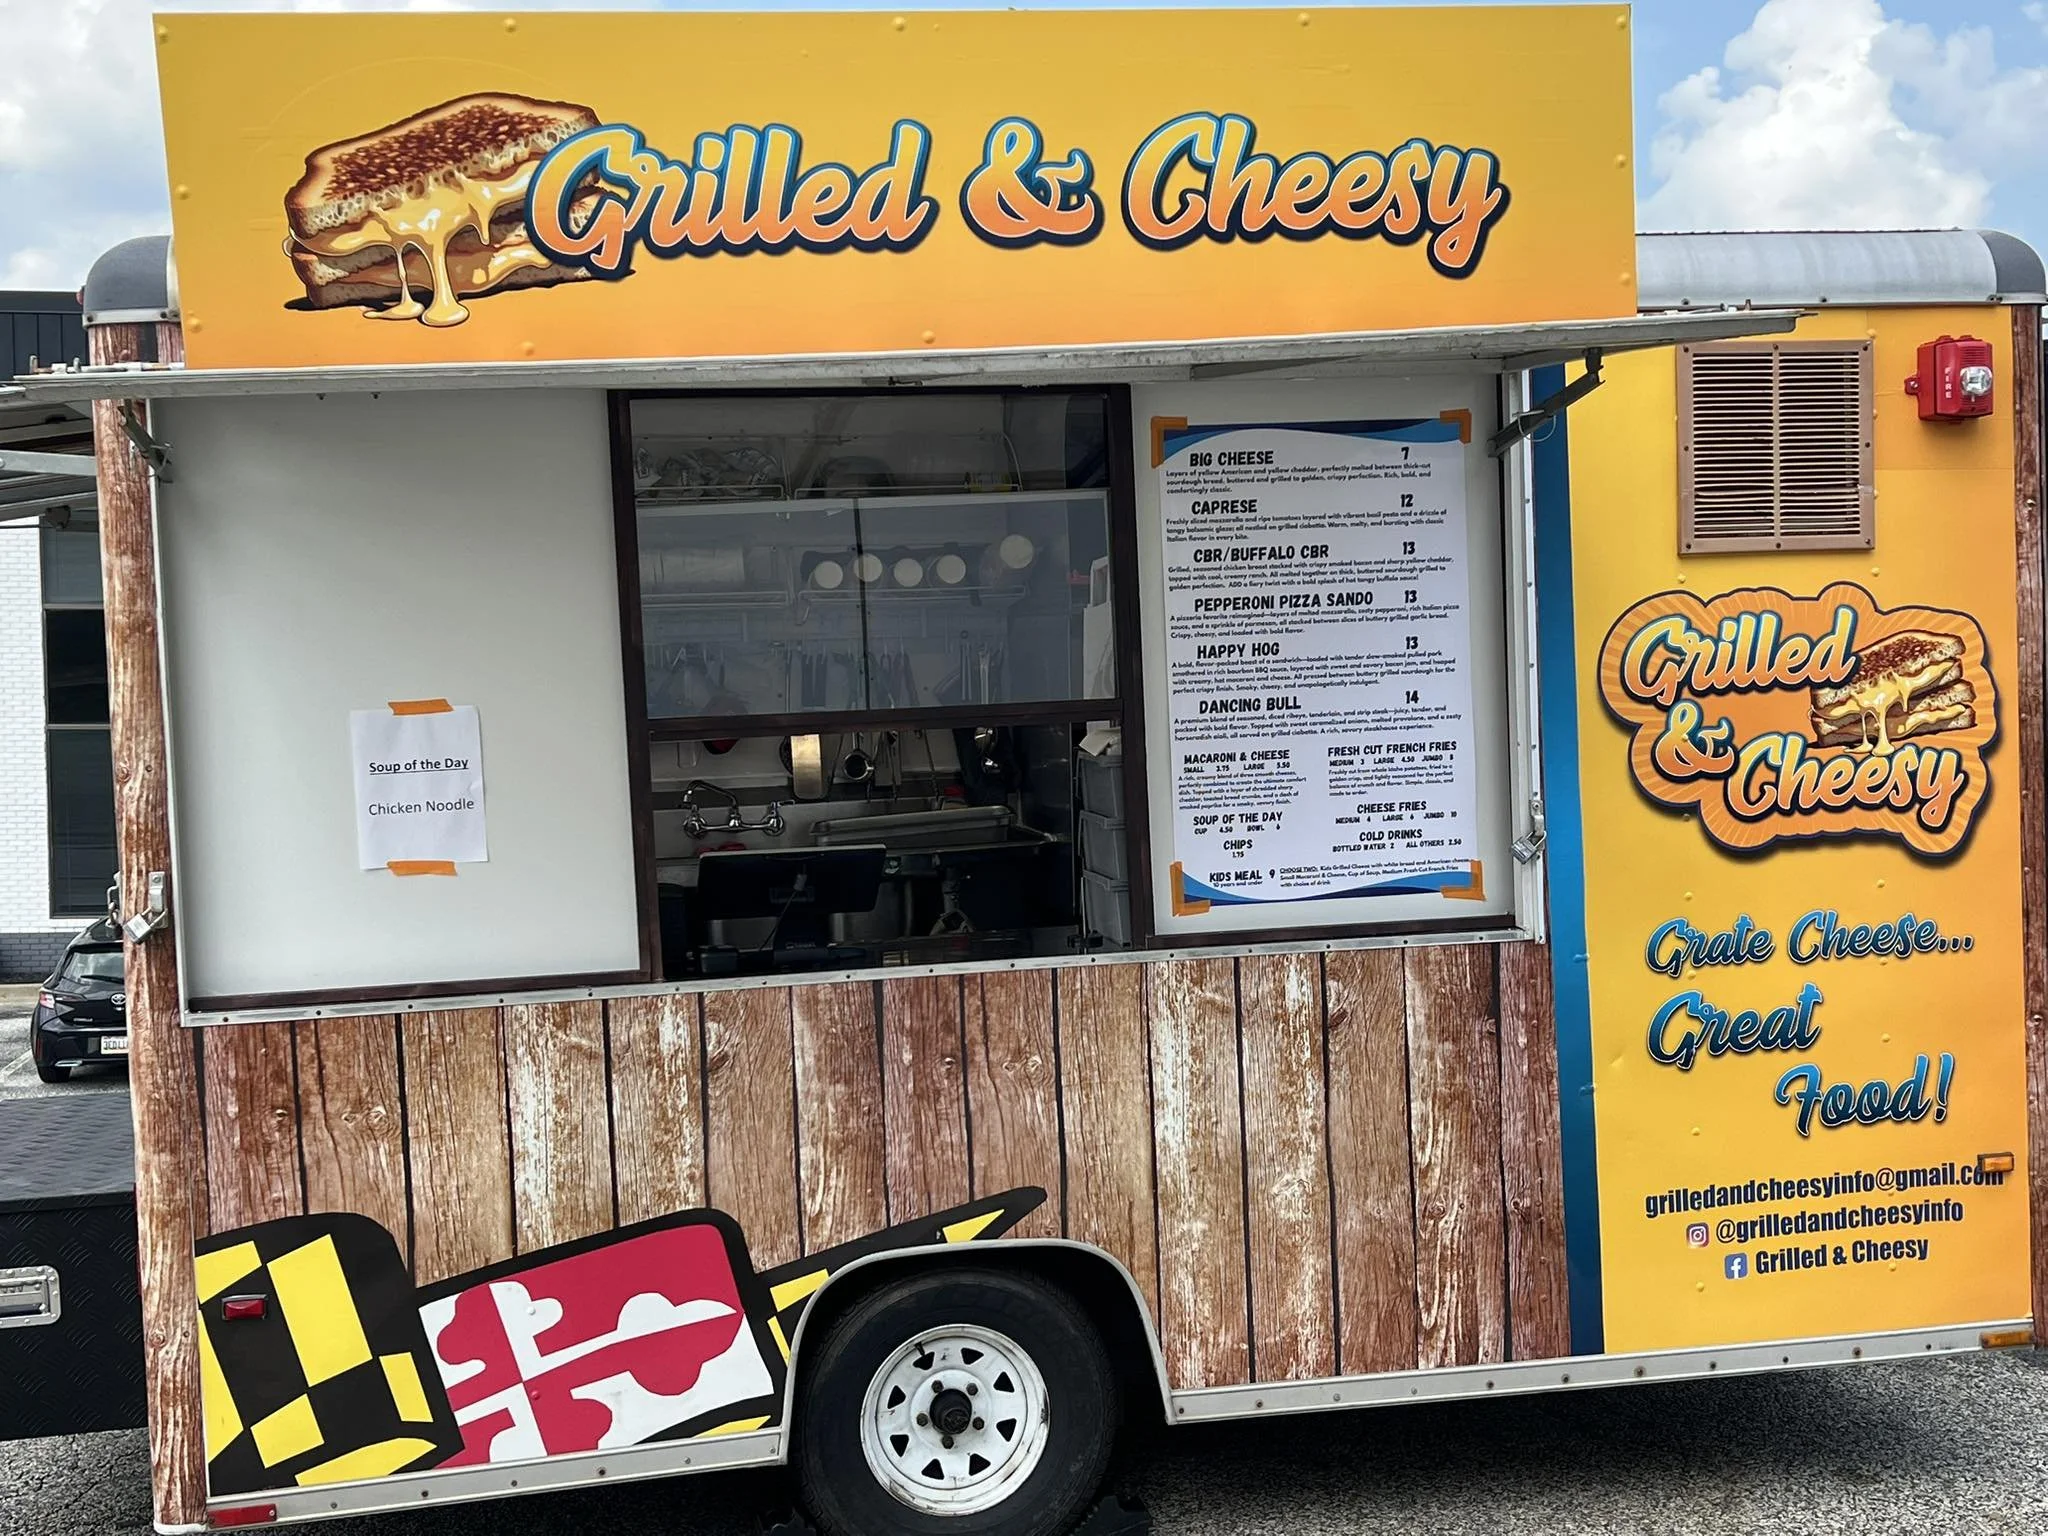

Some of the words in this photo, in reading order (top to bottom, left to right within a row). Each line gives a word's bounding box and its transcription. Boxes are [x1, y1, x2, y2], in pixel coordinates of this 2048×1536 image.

[528, 120, 936, 278] Grilled
[962, 117, 1102, 249] &
[1123, 113, 1508, 277] Cheesy
[1944, 366, 1952, 398] FIRE
[1190, 452, 1212, 466] BIG
[1218, 450, 1274, 466] CHEESE
[1401, 446, 1410, 460] 7
[1192, 499, 1258, 514] CAPRESE
[1401, 494, 1413, 507] 12
[1194, 546, 1295, 563] CBR/BUFFALO
[1301, 544, 1329, 559] CBR
[1403, 542, 1415, 555] 13
[1195, 595, 1275, 612] PEPPERONI
[1280, 594, 1321, 608] PIZZA
[1327, 592, 1373, 607] SANDO
[1405, 590, 1417, 603] 13
[1197, 643, 1246, 659] HAPPY
[1252, 642, 1280, 656] HOG
[1406, 636, 1418, 649] 13
[1623, 604, 1858, 706] Grilled
[1200, 698, 1261, 714] DANCING
[1266, 696, 1301, 711] BULL
[1406, 690, 1419, 704] 14
[1328, 746, 1360, 757] FRESH
[1364, 745, 1383, 755] CUT
[1386, 742, 1426, 754] FRENCH
[1429, 741, 1457, 752] FRIES
[1654, 699, 1736, 778] &
[369, 762, 400, 774] Soup
[404, 760, 416, 770] of
[421, 759, 441, 769] the
[444, 758, 469, 770] Day
[1184, 752, 1236, 764] MACARONI
[1240, 752, 1247, 761] &
[1250, 750, 1290, 761] CHEESE
[1727, 732, 1964, 828] Cheesy
[368, 803, 422, 816] Chicken
[426, 798, 474, 812] Noodle
[1357, 802, 1395, 814] CHEESE
[1399, 801, 1427, 812] FRIES
[1193, 815, 1219, 826] SOUP
[1222, 814, 1235, 824] OF
[1239, 813, 1258, 823] THE
[1262, 812, 1282, 821] DAY
[1224, 839, 1253, 850] CHIPS
[1360, 831, 1384, 841] COLD
[1388, 829, 1422, 840] DRINKS
[1332, 844, 1361, 852] BOTTLED
[1209, 872, 1231, 882] KIDS
[1235, 870, 1262, 881] MEAL
[1269, 869, 1275, 879] 9
[1646, 914, 1774, 976] Grate
[1787, 910, 1974, 965] Cheese...
[1647, 982, 1823, 1070] Great
[1775, 1052, 1955, 1137] Food!
[1716, 1198, 1964, 1244] @grilledandcheesyinfo
[1756, 1245, 1827, 1274] Grilled
[1832, 1246, 1848, 1265] &
[1852, 1238, 1929, 1264] Cheesy
